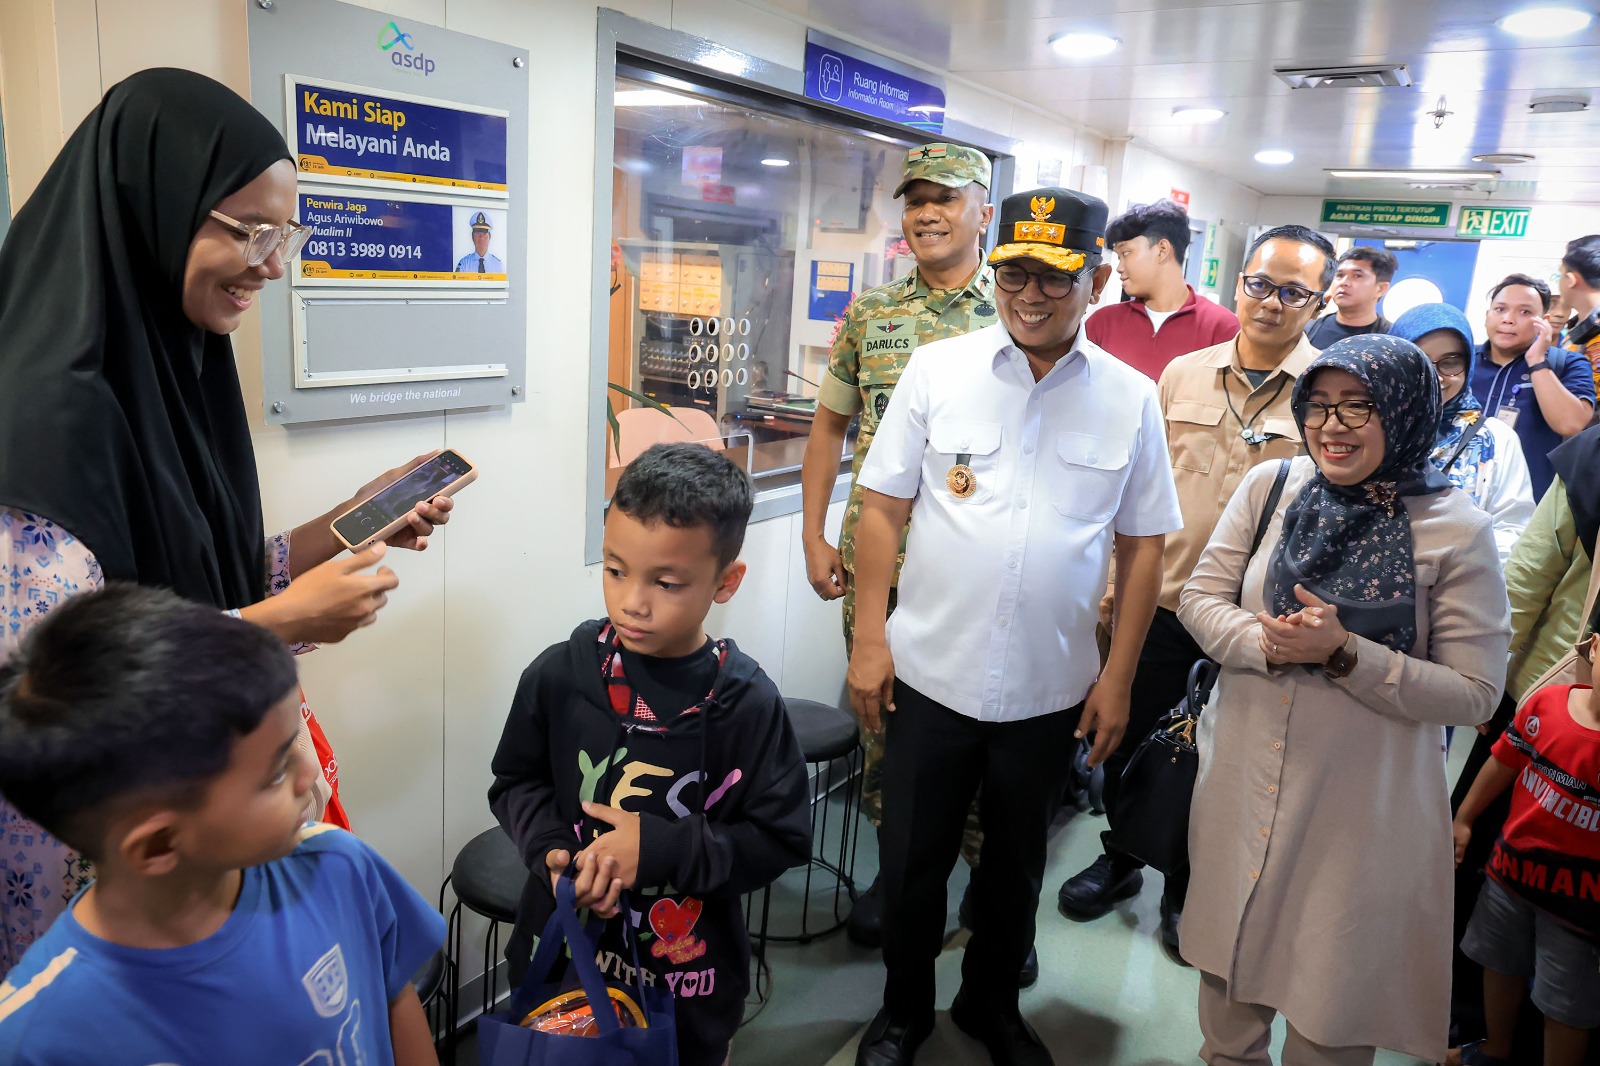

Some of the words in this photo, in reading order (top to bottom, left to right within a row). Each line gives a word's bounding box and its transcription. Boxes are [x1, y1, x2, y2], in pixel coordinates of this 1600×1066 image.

[391, 51, 435, 76] asdp
[853, 72, 878, 94] Ruang
[880, 80, 910, 101] Informasi
[847, 88, 878, 105] Information
[878, 97, 894, 110] Room
[304, 91, 358, 120] Kami
[363, 101, 406, 131] Siap
[306, 123, 397, 156] Melayani
[402, 137, 451, 162] Anda
[306, 198, 344, 211] Perwira
[346, 200, 367, 213] Jaga
[1336, 204, 1372, 212] PASTIKAN
[1372, 205, 1395, 213] PINTU
[307, 212, 332, 224] Agus
[334, 213, 384, 227] Ariwibowo
[1330, 212, 1356, 220] AGAR
[1357, 213, 1370, 221] AC
[1373, 214, 1403, 222] TETAP
[1405, 215, 1441, 223] DINGIN
[1489, 210, 1530, 235] EXIT
[309, 226, 344, 238] Mualim
[308, 240, 346, 256] 0813
[350, 243, 385, 258] 3989
[388, 244, 422, 259] 0914
[866, 338, 909, 352] DARU.CS
[350, 392, 367, 404] We
[369, 391, 403, 404] bridge
[405, 390, 421, 400] the
[423, 387, 461, 399] national
[664, 967, 715, 998] YOU
